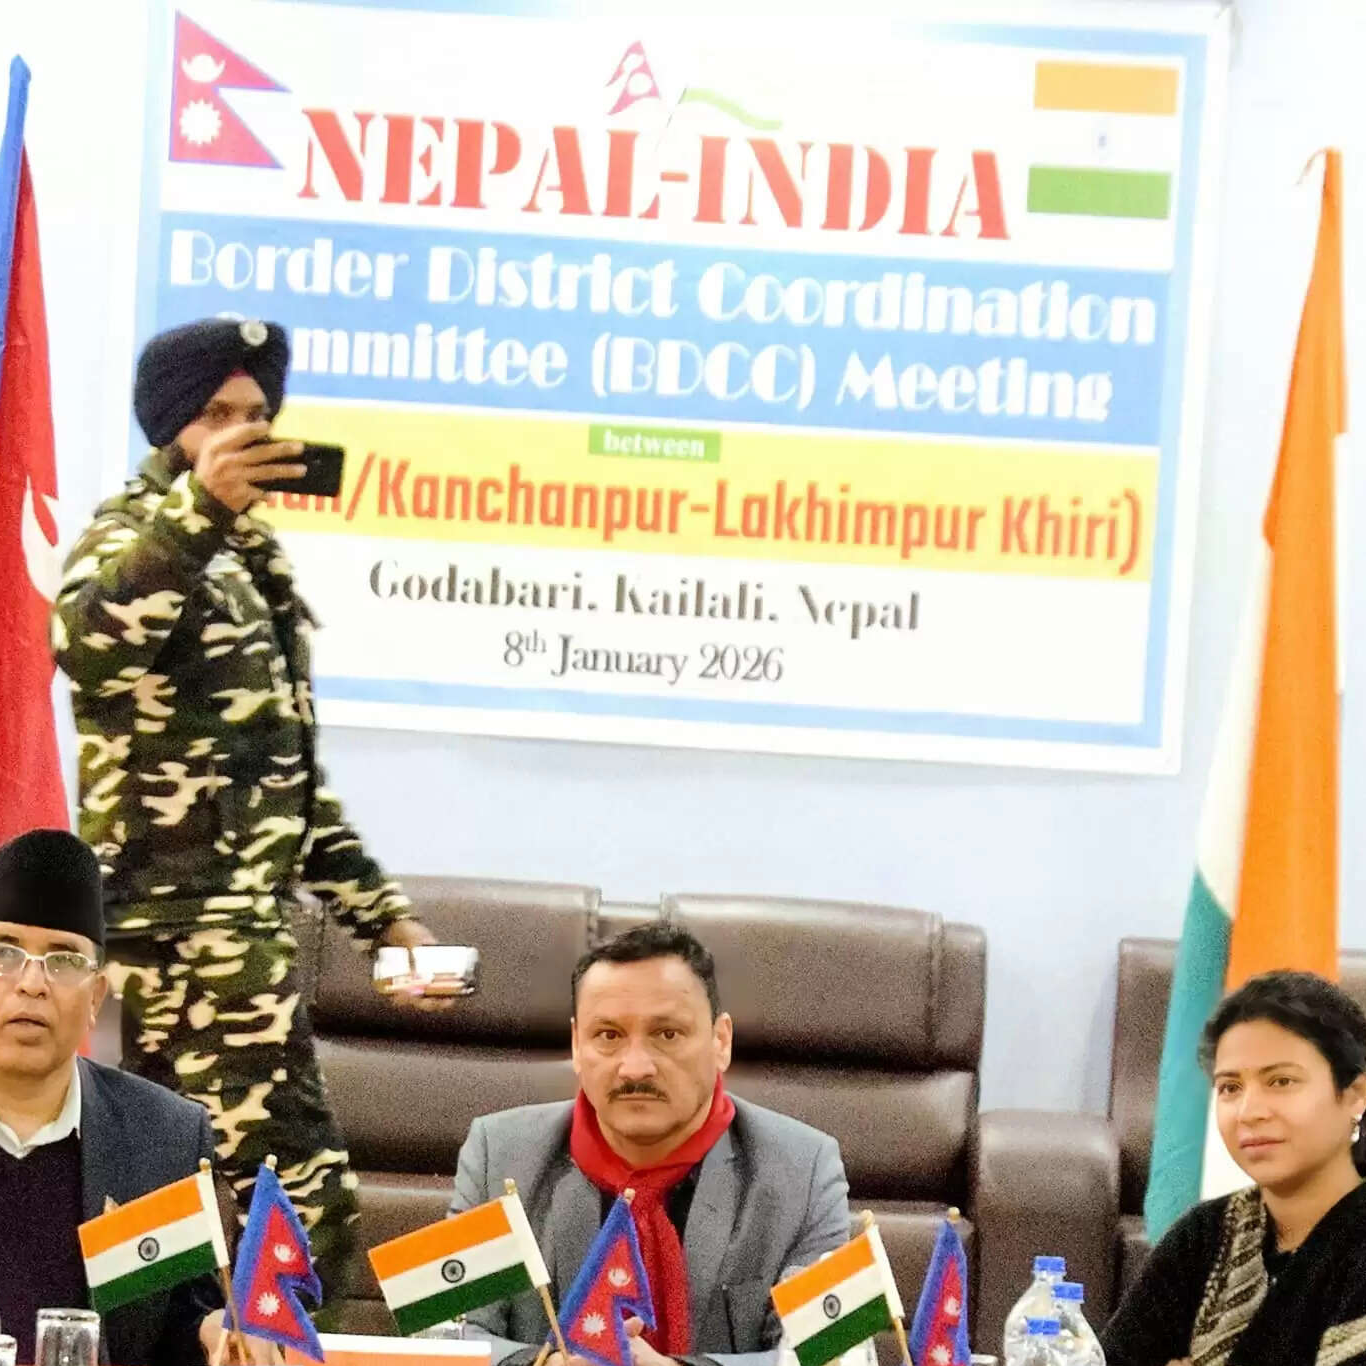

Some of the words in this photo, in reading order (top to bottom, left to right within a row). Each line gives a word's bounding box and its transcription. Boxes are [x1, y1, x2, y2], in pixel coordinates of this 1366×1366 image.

[296, 107, 1011, 240] NEPAL-INDIA
[170, 229, 409, 299] Border
[427, 246, 679, 319] District
[697, 261, 1156, 345] Coordination
[213, 311, 569, 389] mmittee
[591, 331, 816, 412] (BDCC)
[835, 350, 1113, 424] Meeting
[603, 429, 705, 459] between
[1000, 487, 1143, 576] Khiri)
[798, 584, 921, 640] Nepal
[503, 629, 547, 668] 8th
[550, 633, 689, 686] January
[698, 643, 785, 682] 2026
